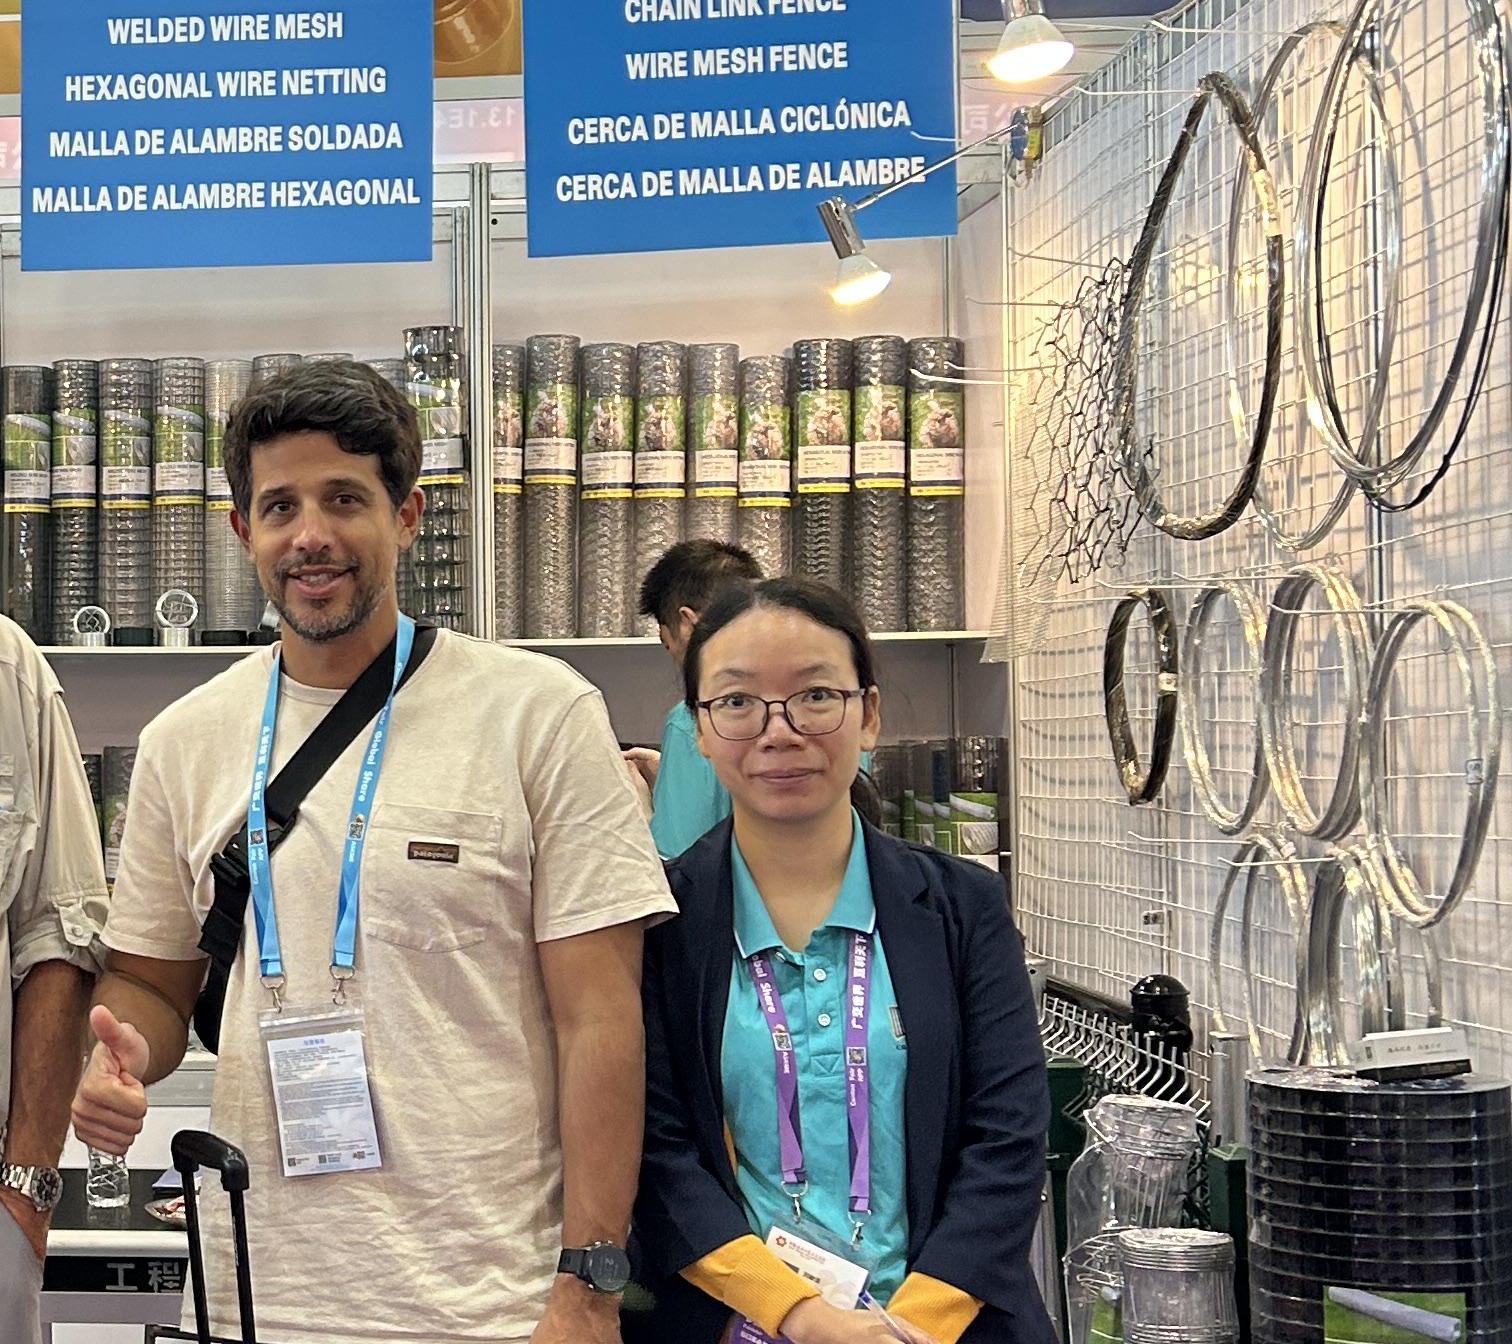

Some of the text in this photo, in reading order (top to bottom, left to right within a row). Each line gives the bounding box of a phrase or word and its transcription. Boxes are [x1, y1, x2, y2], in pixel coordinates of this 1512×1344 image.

[107, 12, 344, 45] WELDED WIRE MESH
[625, 41, 849, 80] WIRE MESH FENCE
[65, 66, 387, 102] HEXAGONAL WIRE NETTING
[567, 97, 912, 145] CERCA DE MALLA CICLÓNICA
[49, 122, 403, 158] MALLA DE ALAMBRE SOLDADA
[32, 178, 420, 214] MALLA DE ALAMBRE HEXAGONAL
[556, 157, 926, 203] CERCA DE MALLA DE ALAMBRE
[366, 730, 382, 765] Global
[357, 771, 374, 802] Share
[759, 981, 777, 1014] Share
[105, 1262, 182, 1293] 工程
